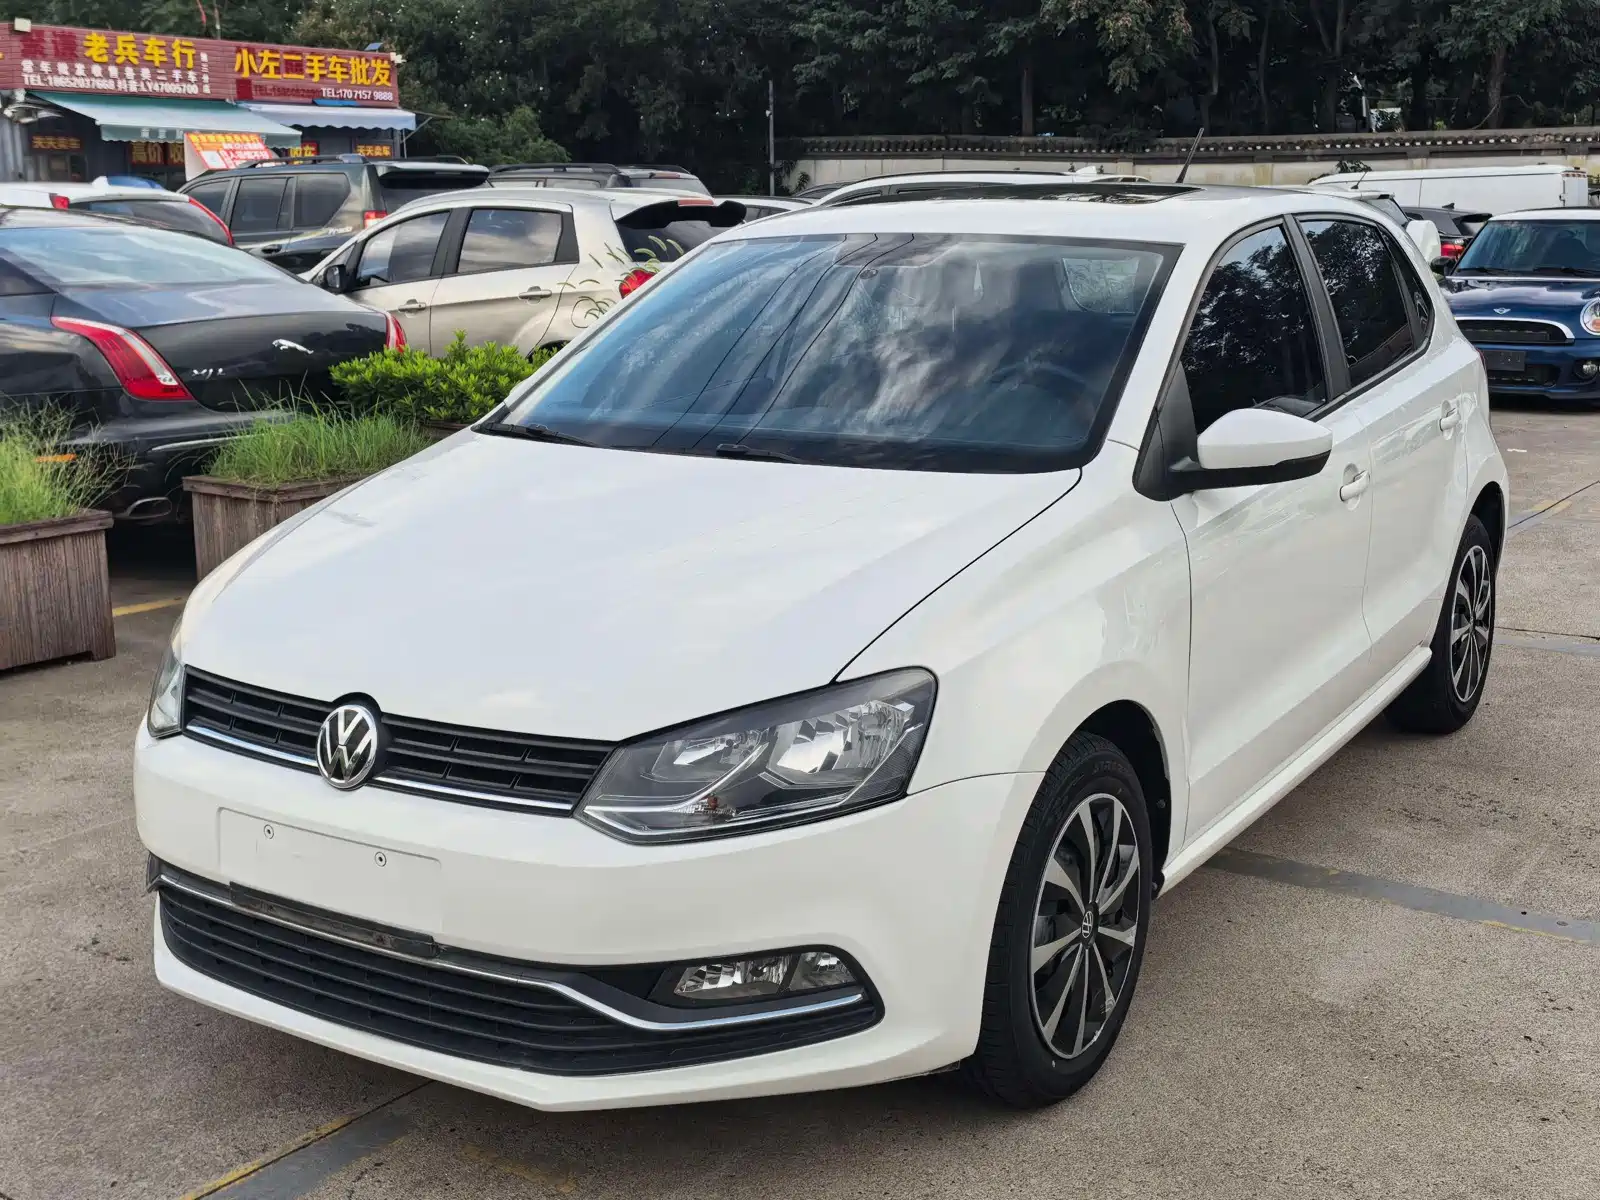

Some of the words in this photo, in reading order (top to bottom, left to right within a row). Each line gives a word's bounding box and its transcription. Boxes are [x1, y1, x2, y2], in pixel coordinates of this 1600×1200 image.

[83, 32, 196, 69] 老兵车行
[234, 47, 391, 87] 小左二手车批发
[353, 89, 371, 100] 7157
